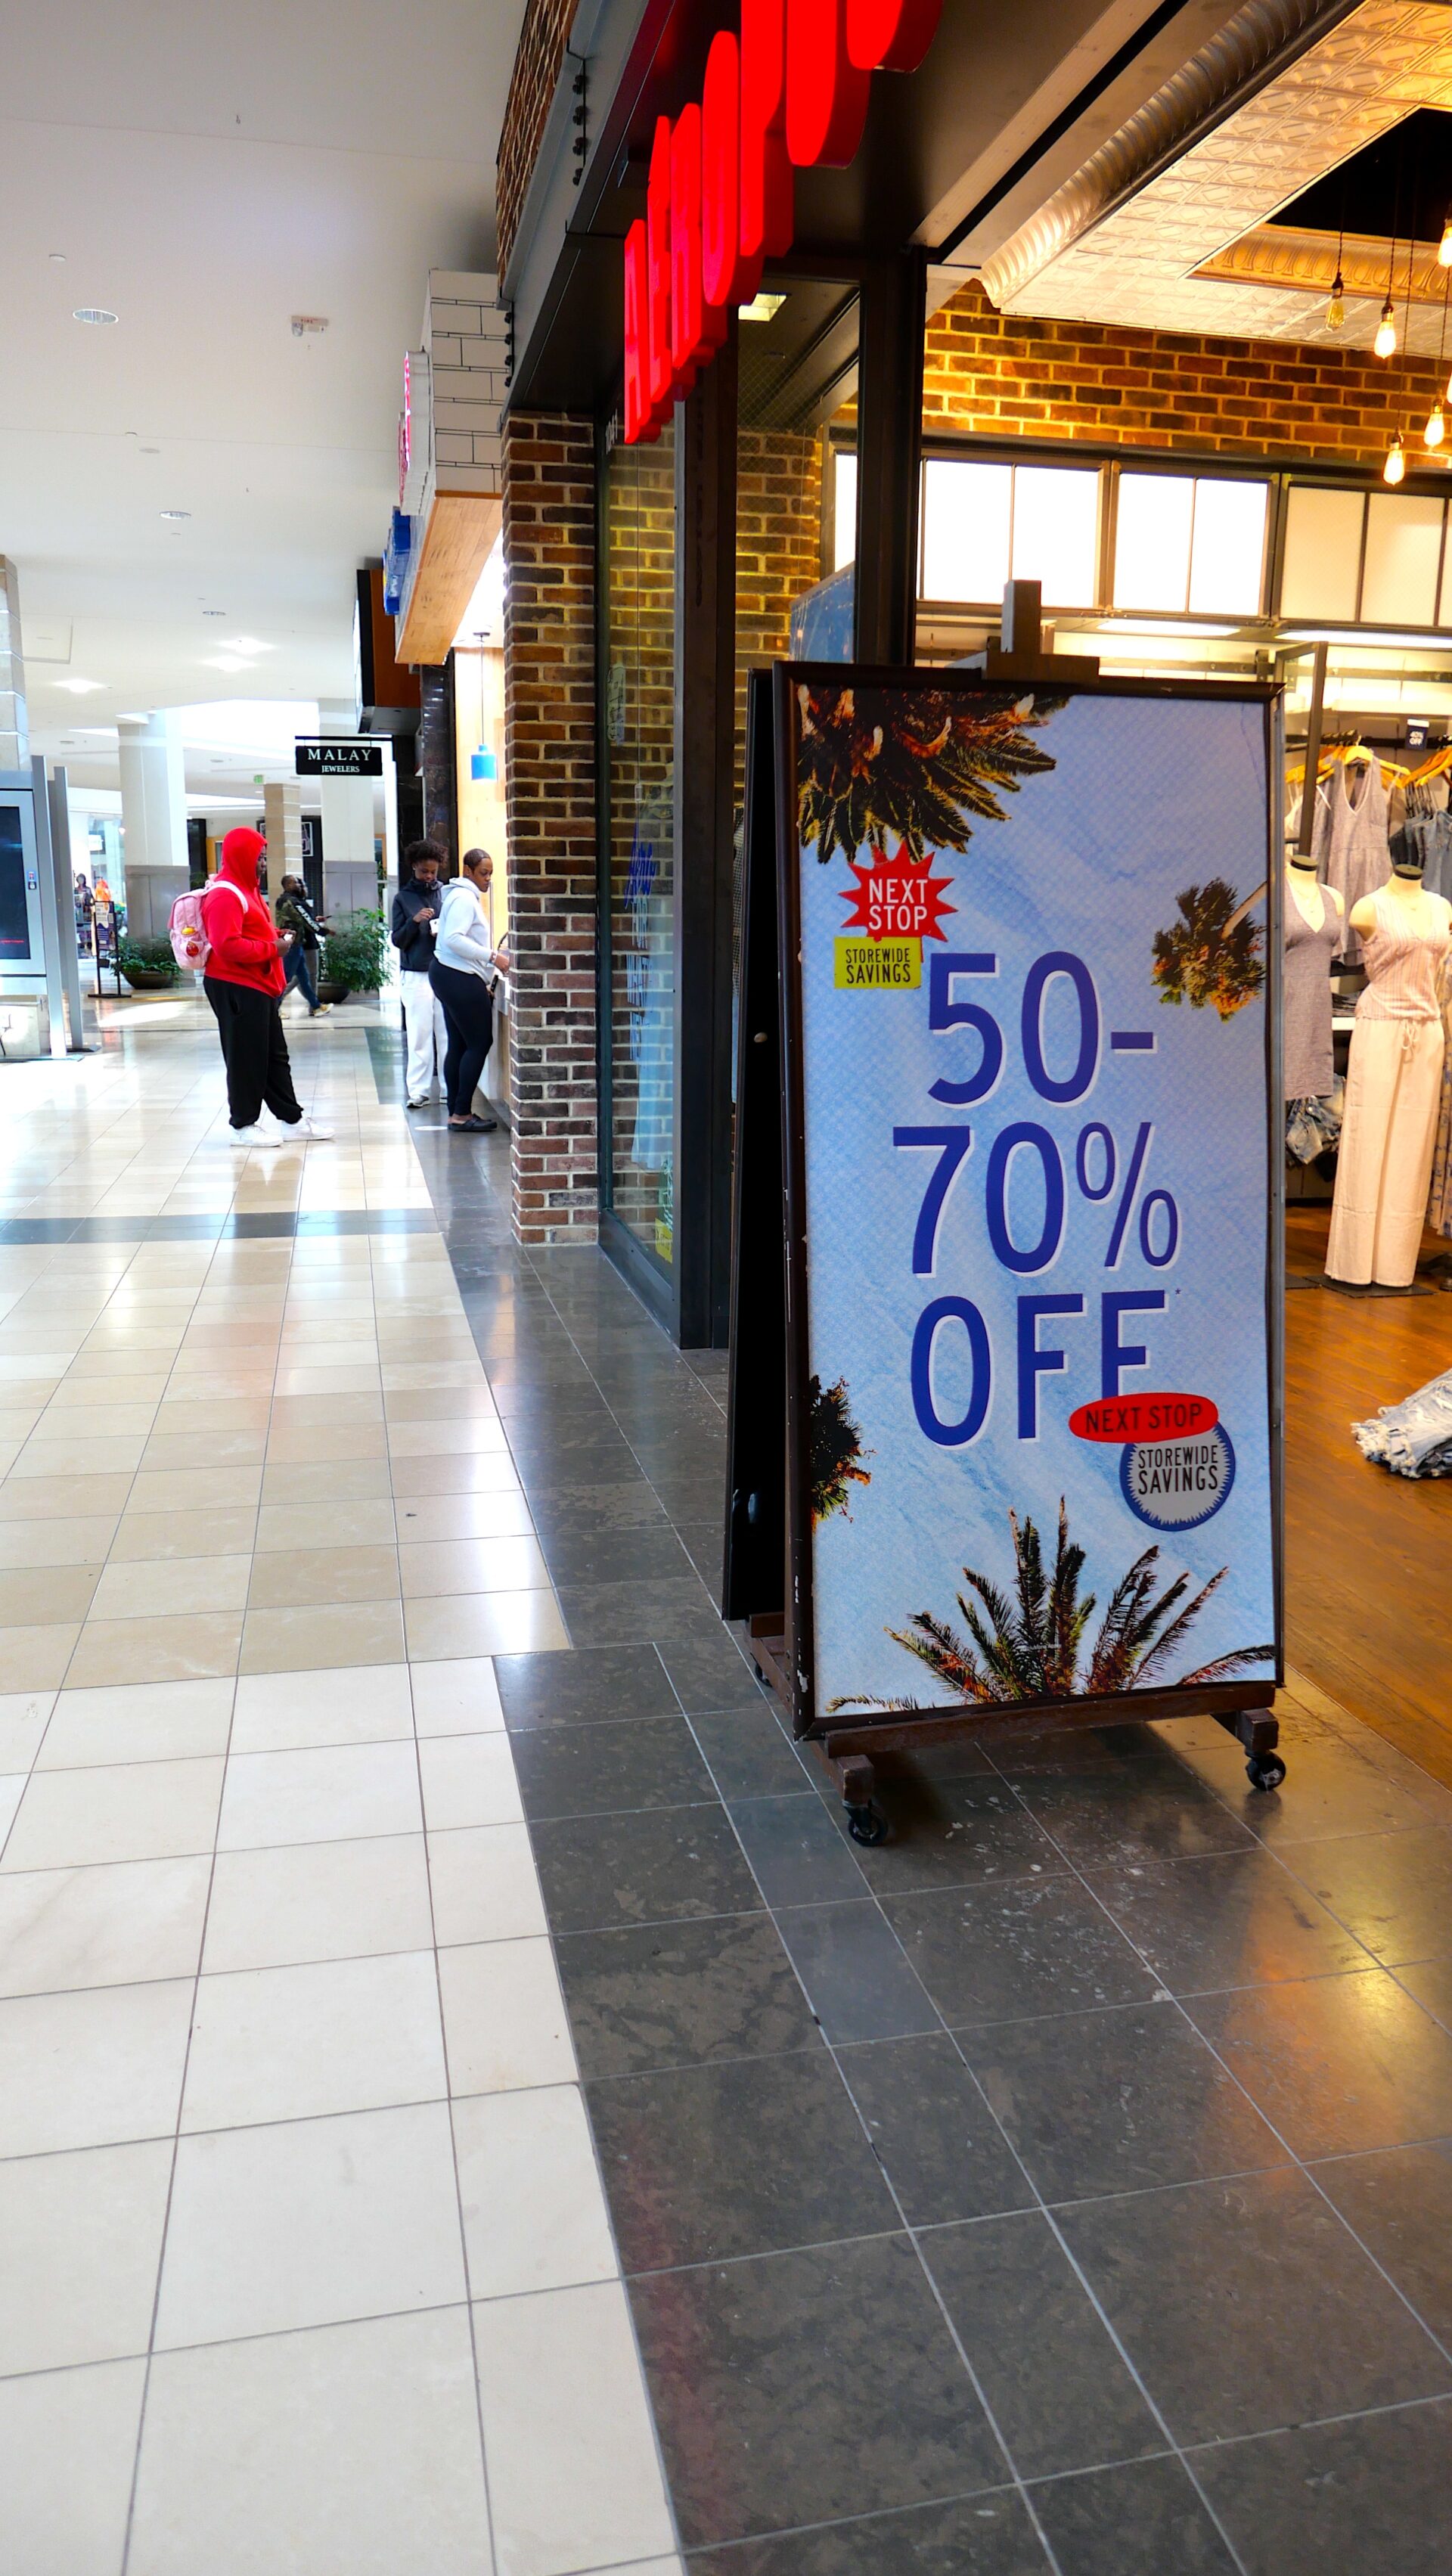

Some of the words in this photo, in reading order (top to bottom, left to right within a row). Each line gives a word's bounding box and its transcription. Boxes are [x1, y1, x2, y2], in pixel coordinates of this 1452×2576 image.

[307, 748, 371, 761] MALAY
[321, 765, 360, 773] JEWELERS
[868, 878, 929, 904] NEXT
[868, 905, 928, 931] STOP
[845, 948, 911, 964] STOREWIDE
[845, 963, 911, 984] SAVINGS
[927, 951, 1156, 1106] 50-
[892, 1121, 1181, 1275] 70%
[1085, 1406, 1141, 1433] NEXT
[1148, 1402, 1203, 1429] STOP
[1137, 1445, 1219, 1469] STOREWIDE
[1137, 1465, 1219, 1495] SAVINGS
